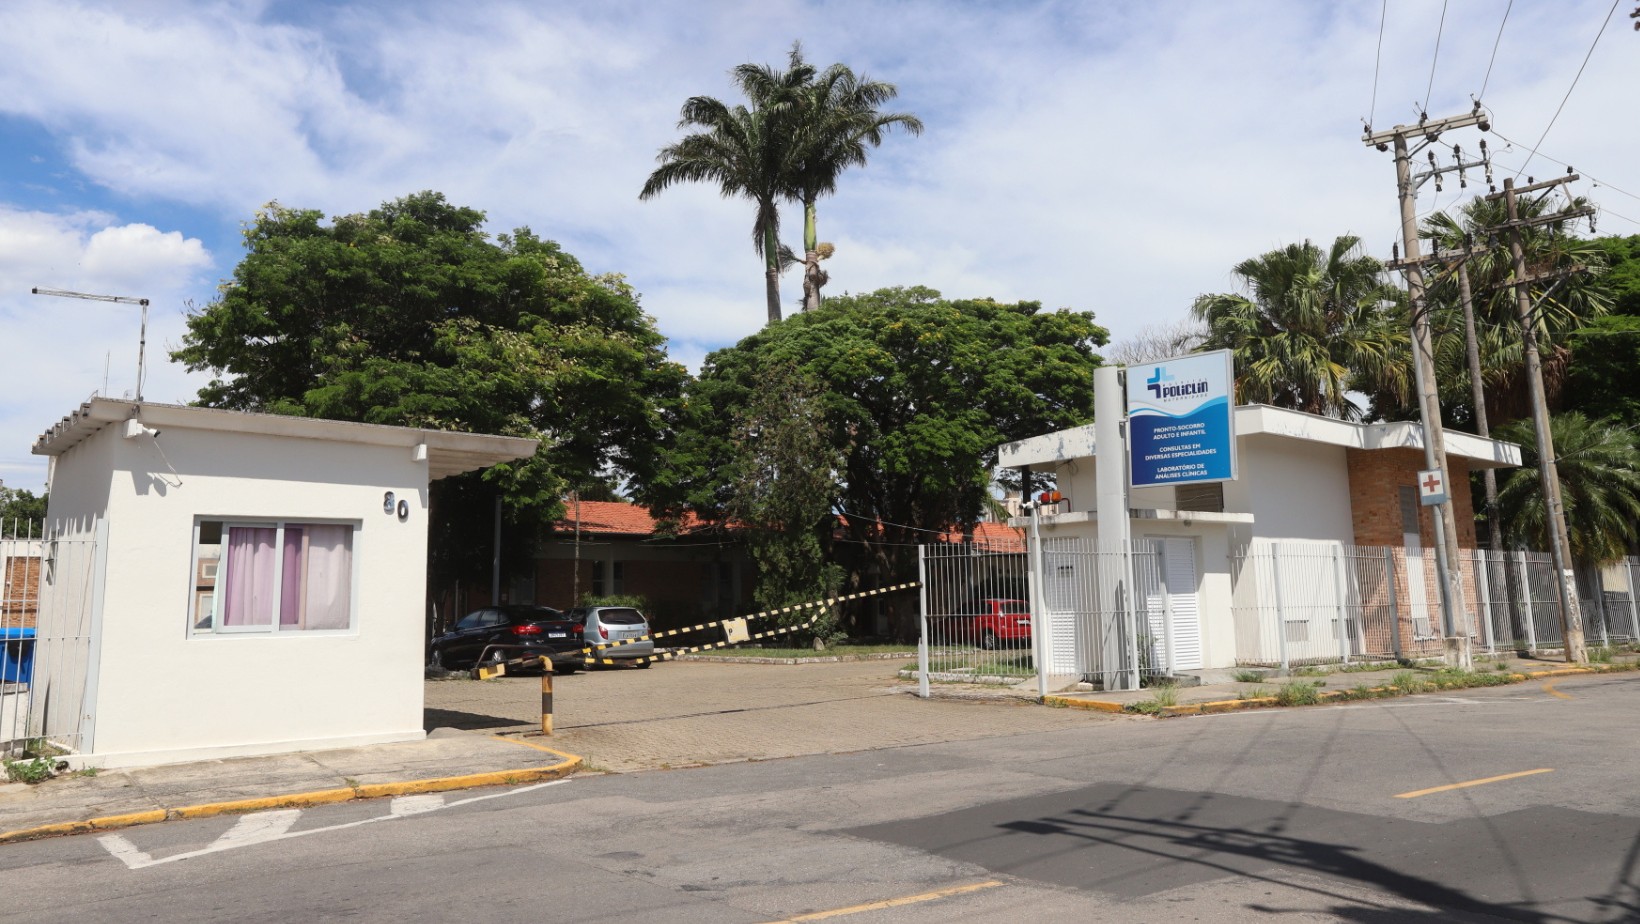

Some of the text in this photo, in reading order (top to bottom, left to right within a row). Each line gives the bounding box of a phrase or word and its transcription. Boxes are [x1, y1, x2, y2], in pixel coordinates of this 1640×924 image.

[1153, 423, 1205, 433] PRONTO-SOCORRO
[1181, 429, 1206, 437] INFANTIL
[1159, 445, 1192, 453] CONSULTAS
[1145, 448, 1217, 461] DIVERSAS ESPECIALIDADES
[1157, 463, 1196, 473] LABORATÓRIO
[383, 490, 409, 523] 80
